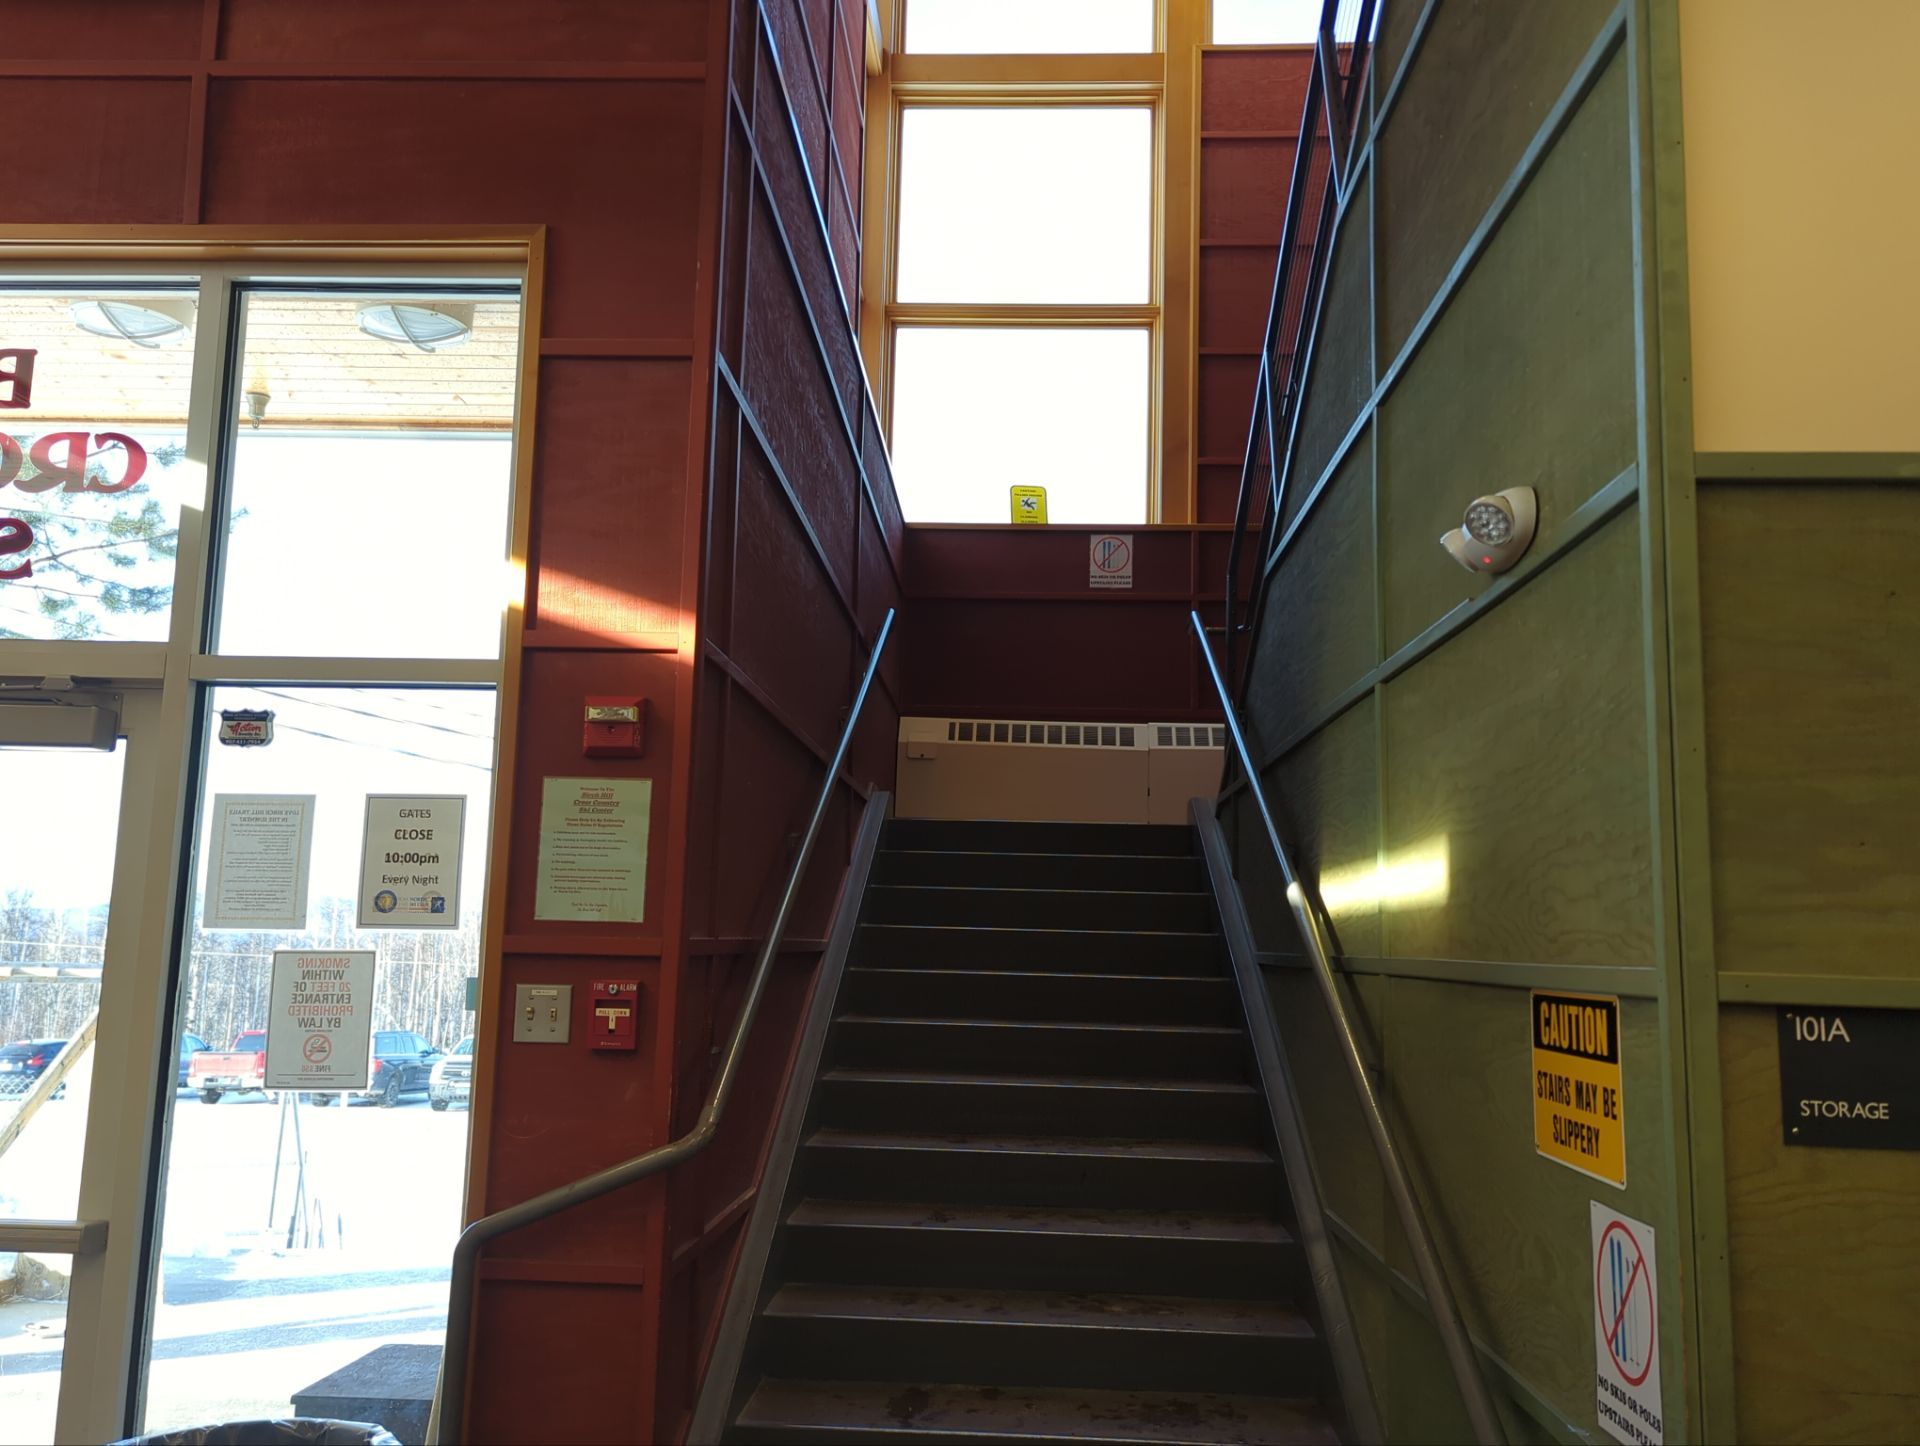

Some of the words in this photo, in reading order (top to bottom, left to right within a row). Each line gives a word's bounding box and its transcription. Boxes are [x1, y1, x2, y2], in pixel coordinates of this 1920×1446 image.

[399, 808, 432, 819] GATES
[394, 829, 434, 841] CLOSE
[384, 852, 440, 866] 10:00pm
[381, 874, 409, 886] Every
[411, 874, 439, 887] Night
[593, 982, 605, 992] FIRE
[619, 982, 638, 992] ALARM
[1540, 1000, 1609, 1057] CAUTION
[1795, 1015, 1851, 1043] 101A
[1537, 1070, 1571, 1107] STAIRS
[1575, 1079, 1598, 1115] MAY
[1602, 1086, 1618, 1121] BE
[1799, 1099, 1890, 1120] STORAGE
[1552, 1113, 1600, 1159] SLIPPERY
[1597, 1374, 1609, 1392] NO
[1609, 1382, 1627, 1406] SKIS
[1627, 1396, 1639, 1415] OR
[1638, 1404, 1662, 1433] POLES
[1598, 1399, 1635, 1438] UPSTAIRS
